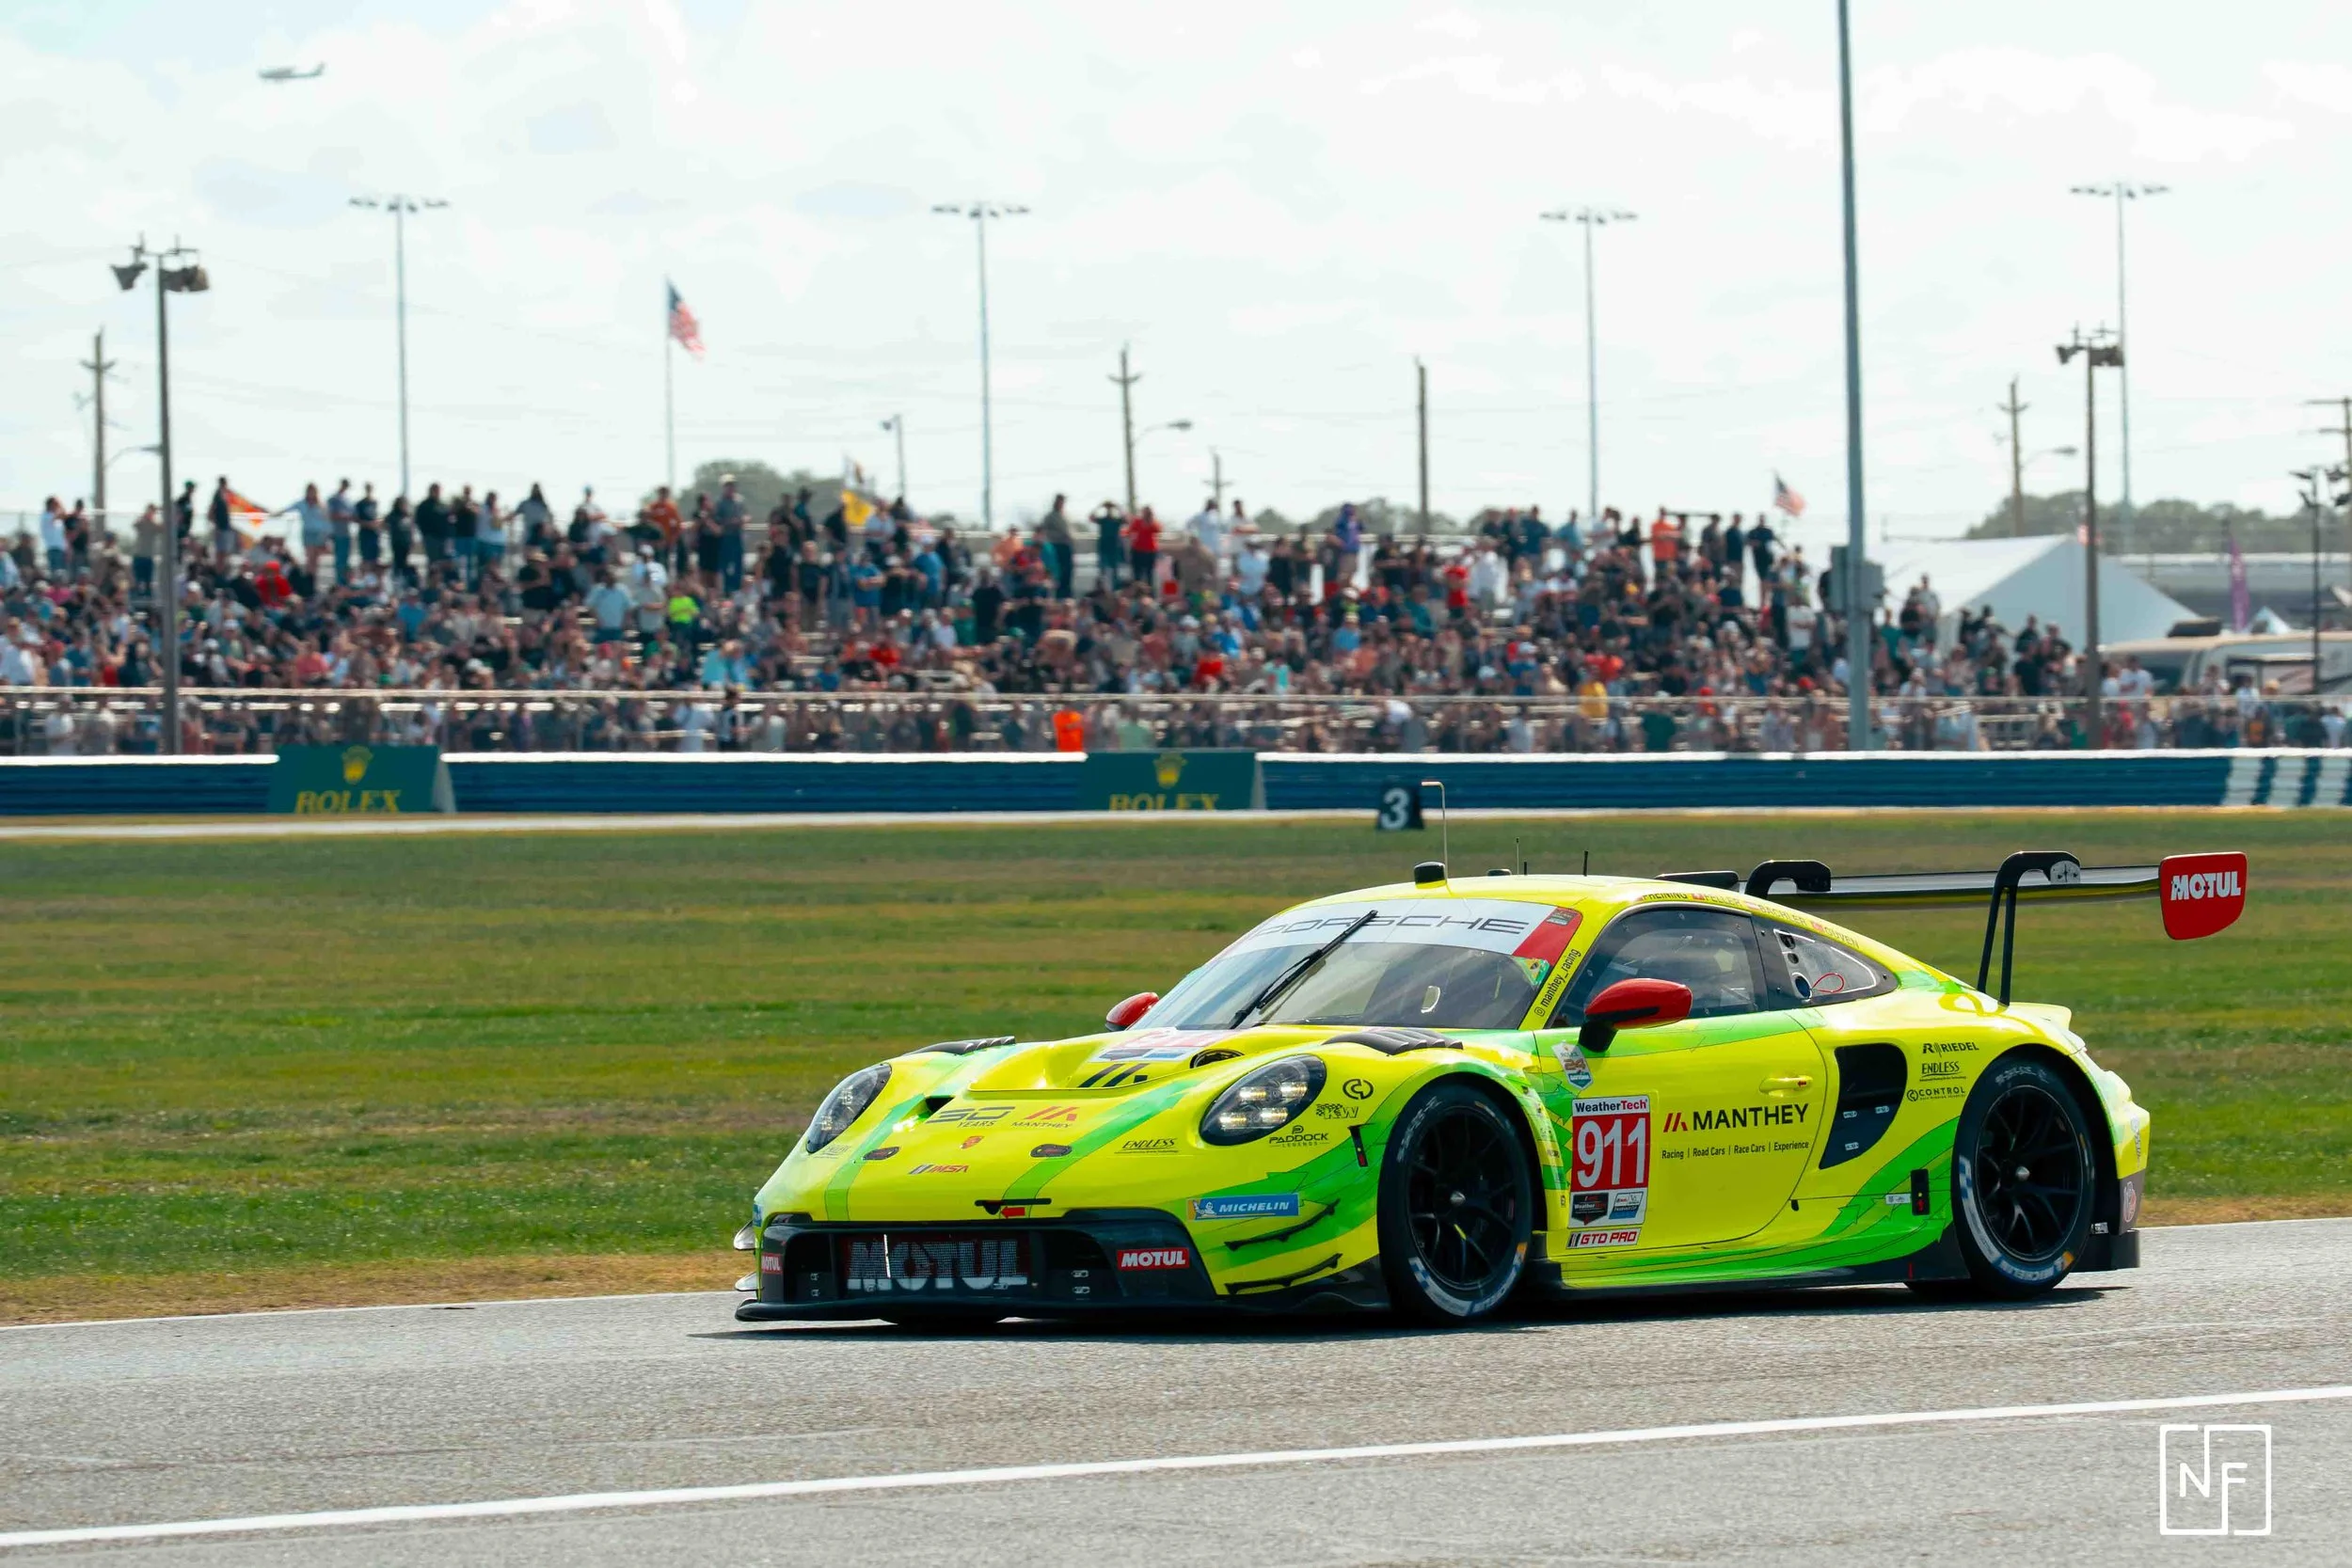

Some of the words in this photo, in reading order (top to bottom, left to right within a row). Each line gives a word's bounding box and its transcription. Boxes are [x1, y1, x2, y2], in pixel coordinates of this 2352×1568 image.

[294, 788, 401, 814] ROLEX
[1381, 787, 1410, 831] 3
[2170, 871, 2242, 901] MOTUL
[1253, 915, 1530, 940] PORSCHE
[1540, 948, 1581, 1007] manthey_racing
[1941, 1041, 1979, 1053] RIEDEL
[1921, 1061, 1960, 1074] ENDLESS
[1919, 1086, 1965, 1097] CONTROL
[925, 1105, 1016, 1124] 30
[1575, 1100, 1647, 1112] WeatherTech
[958, 1119, 995, 1128] YEARS
[1693, 1102, 1808, 1131] MANTHEY
[1121, 1137, 1178, 1148] ENDLESS
[1269, 1132, 1329, 1144] PADDOCK
[1577, 1117, 1647, 1189] 911
[1661, 1149, 1684, 1160] Racing
[1693, 1148, 1709, 1157] Road
[1710, 1146, 1725, 1155] Cars
[1734, 1144, 1749, 1154] Race
[1751, 1143, 1766, 1153] Cars
[1773, 1141, 1809, 1153] Experience
[1218, 1202, 1290, 1213] MICHELIN
[1581, 1233, 1608, 1245] GTD
[1610, 1231, 1638, 1243] PRO
[847, 1240, 1028, 1291] MOTUL
[1120, 1250, 1186, 1268] MOTUL
